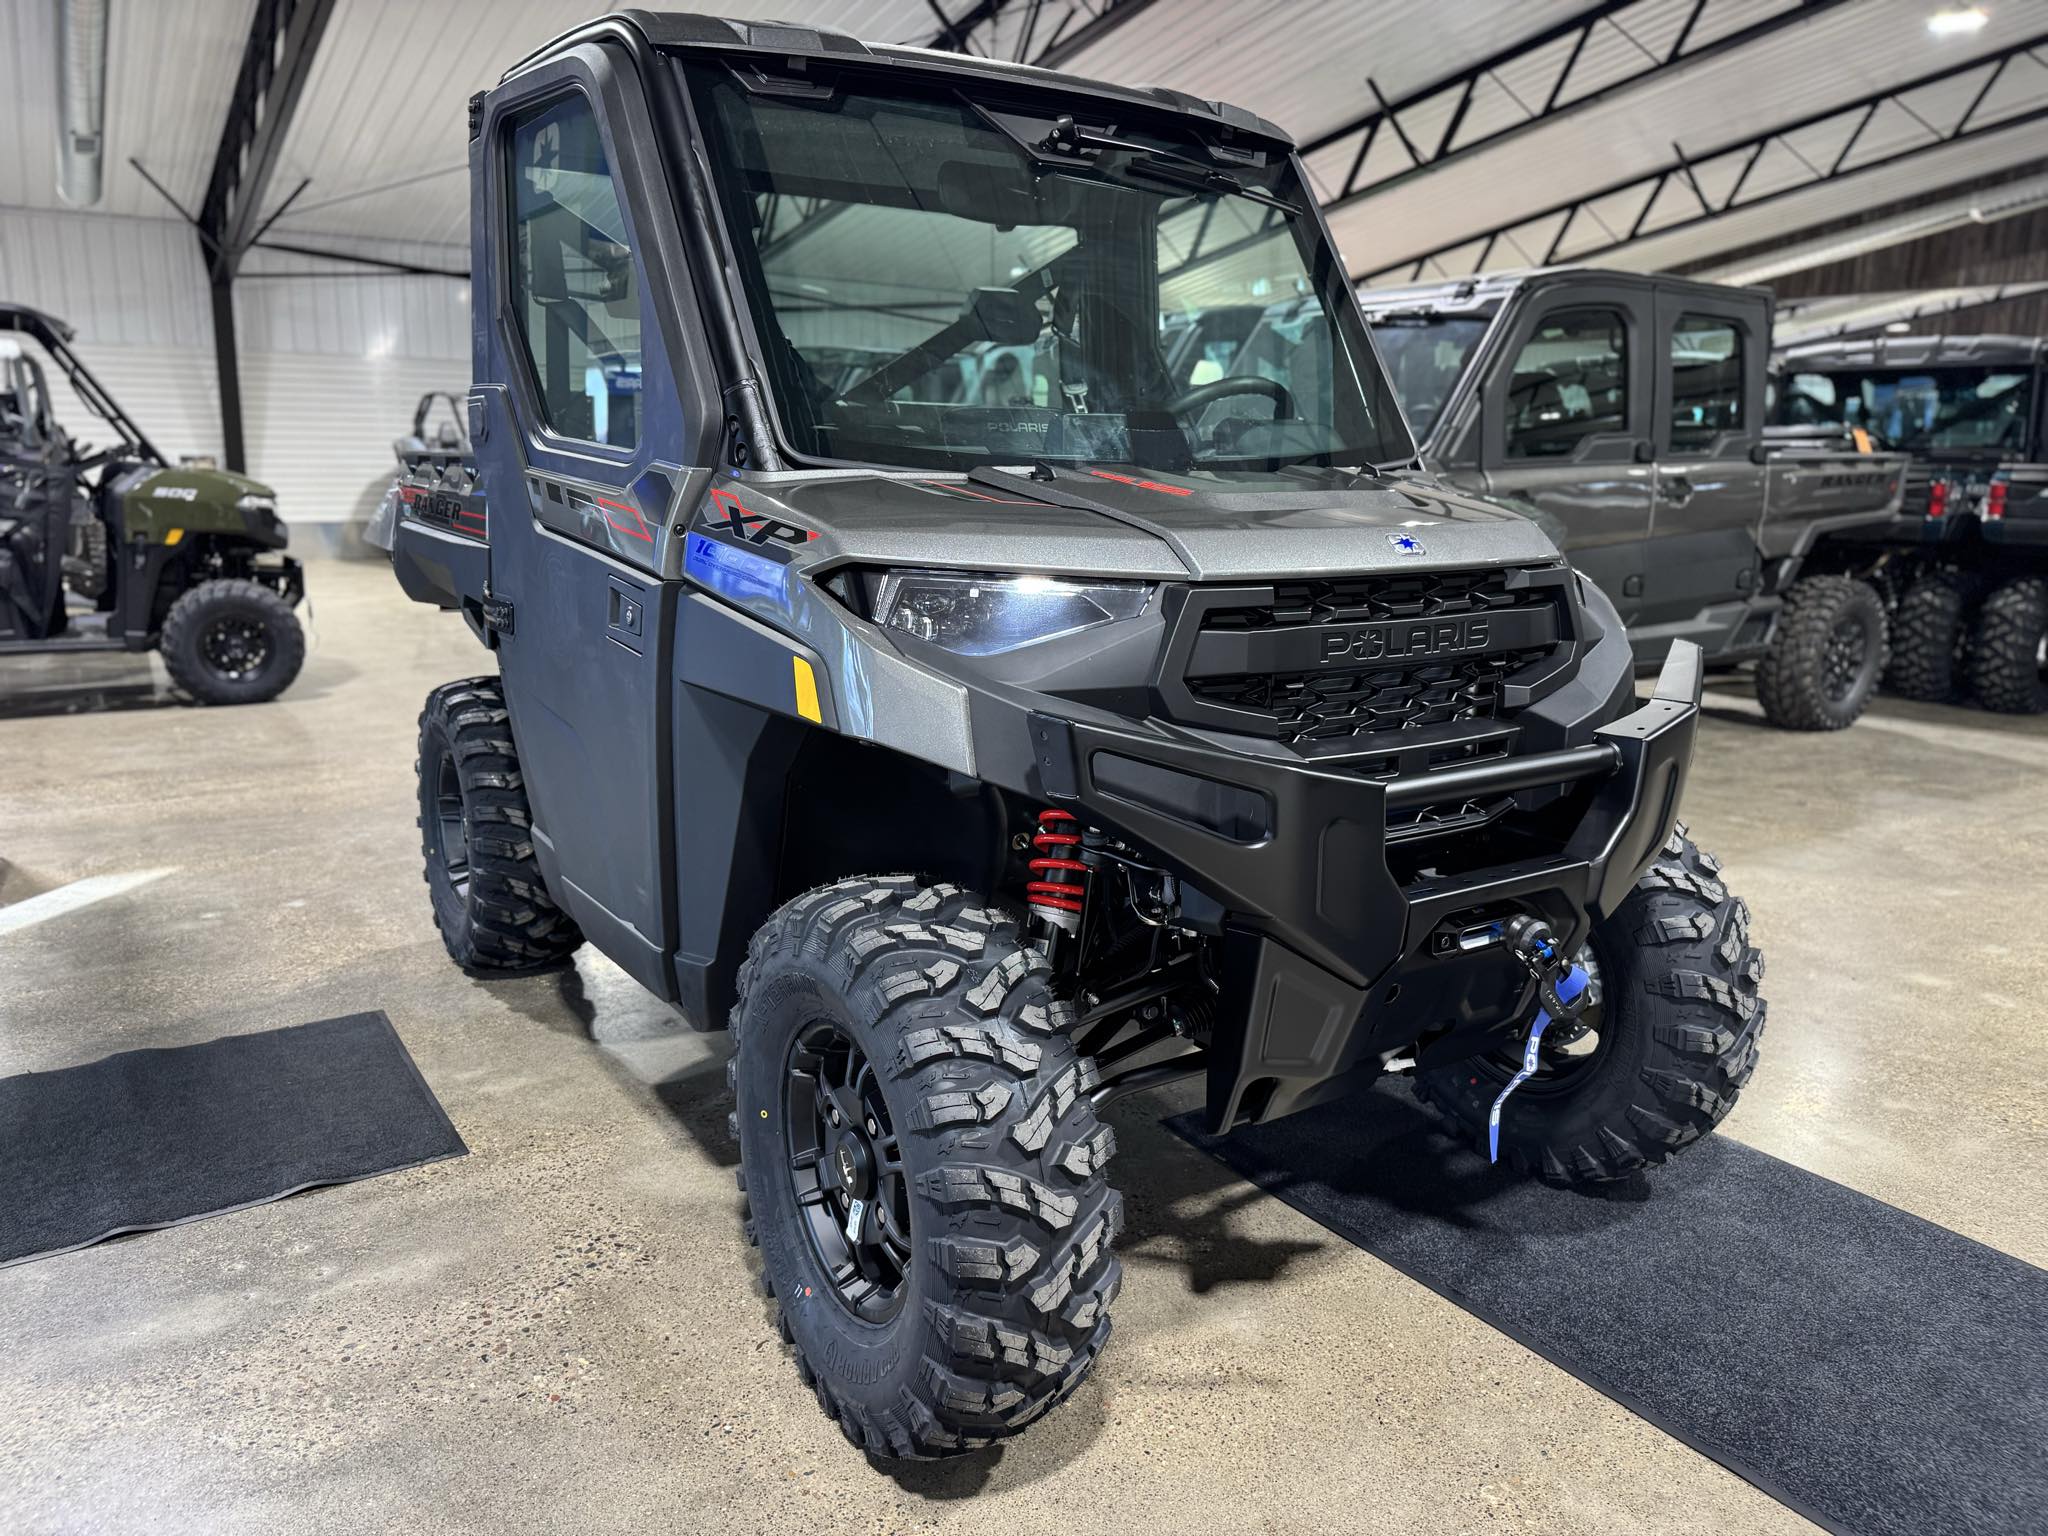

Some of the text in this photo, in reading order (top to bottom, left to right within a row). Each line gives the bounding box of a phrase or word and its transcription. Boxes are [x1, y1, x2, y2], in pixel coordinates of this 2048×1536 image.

[987, 422, 1049, 433] POLARIS
[413, 494, 462, 521] RANGER
[702, 505, 809, 546] XP
[1320, 619, 1491, 664] POLARIS
